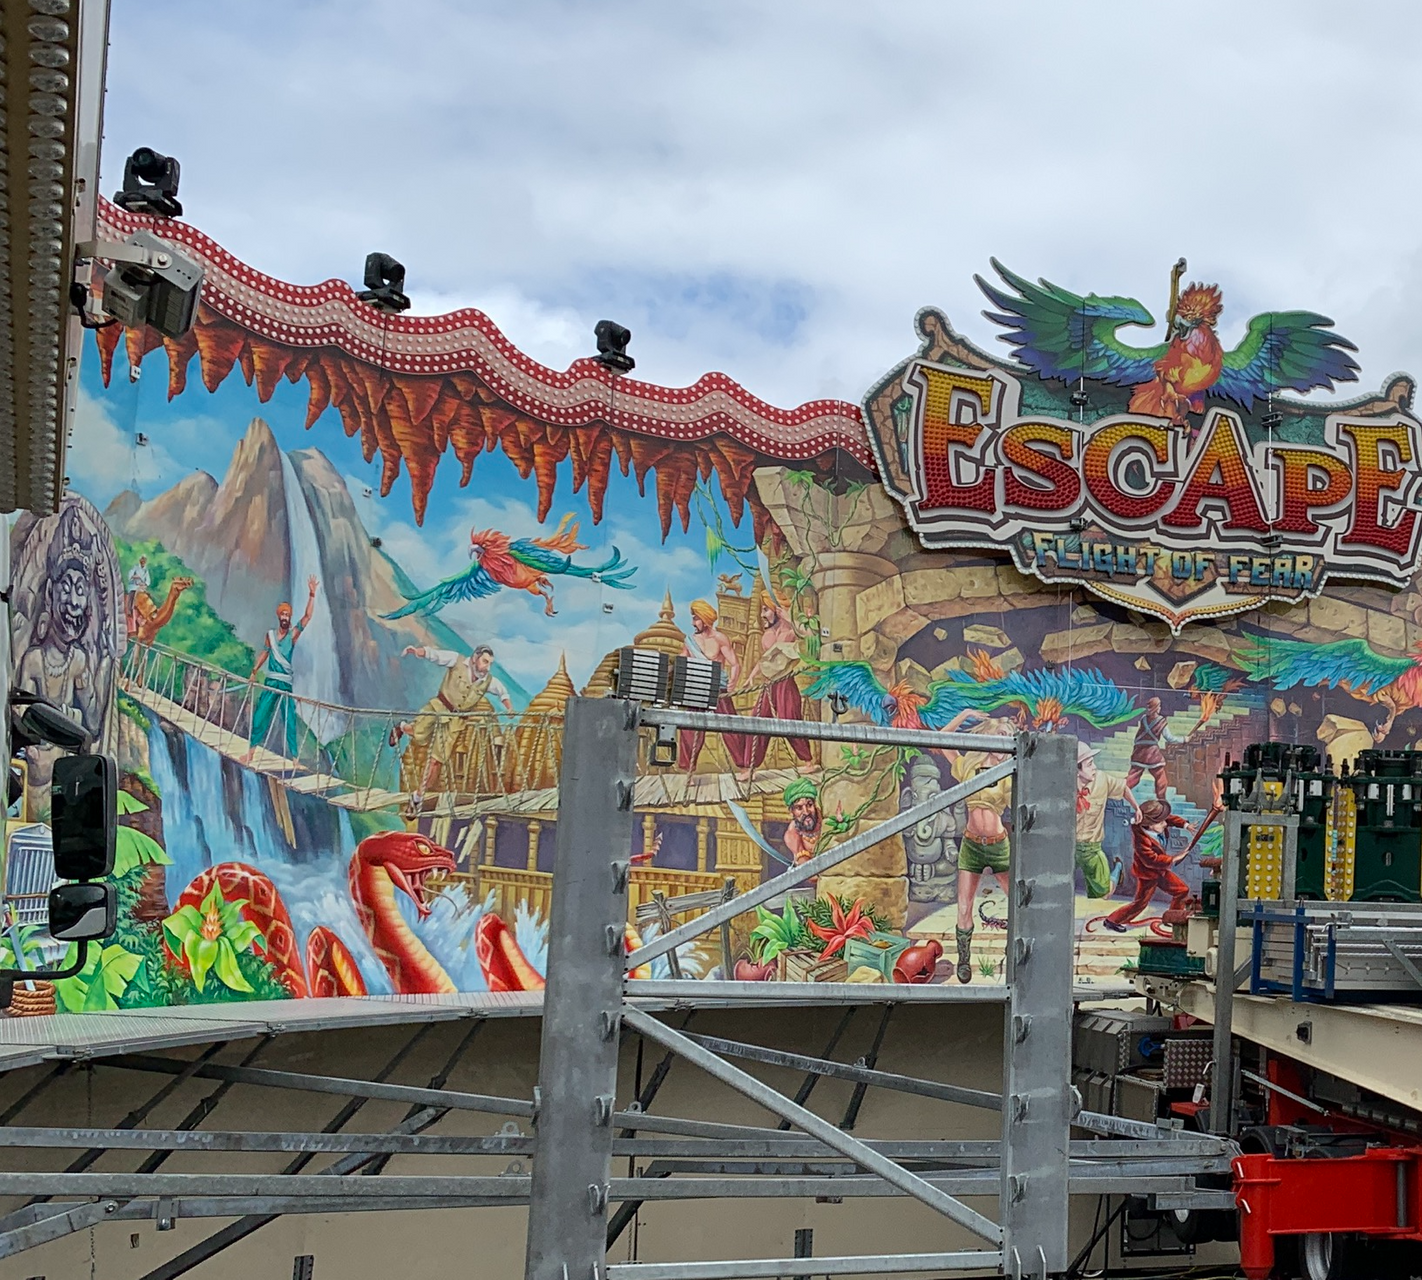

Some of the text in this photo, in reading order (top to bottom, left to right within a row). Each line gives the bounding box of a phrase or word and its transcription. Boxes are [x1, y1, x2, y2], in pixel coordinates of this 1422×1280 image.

[1032, 531, 1315, 589] FLIGHT OF FEAR
